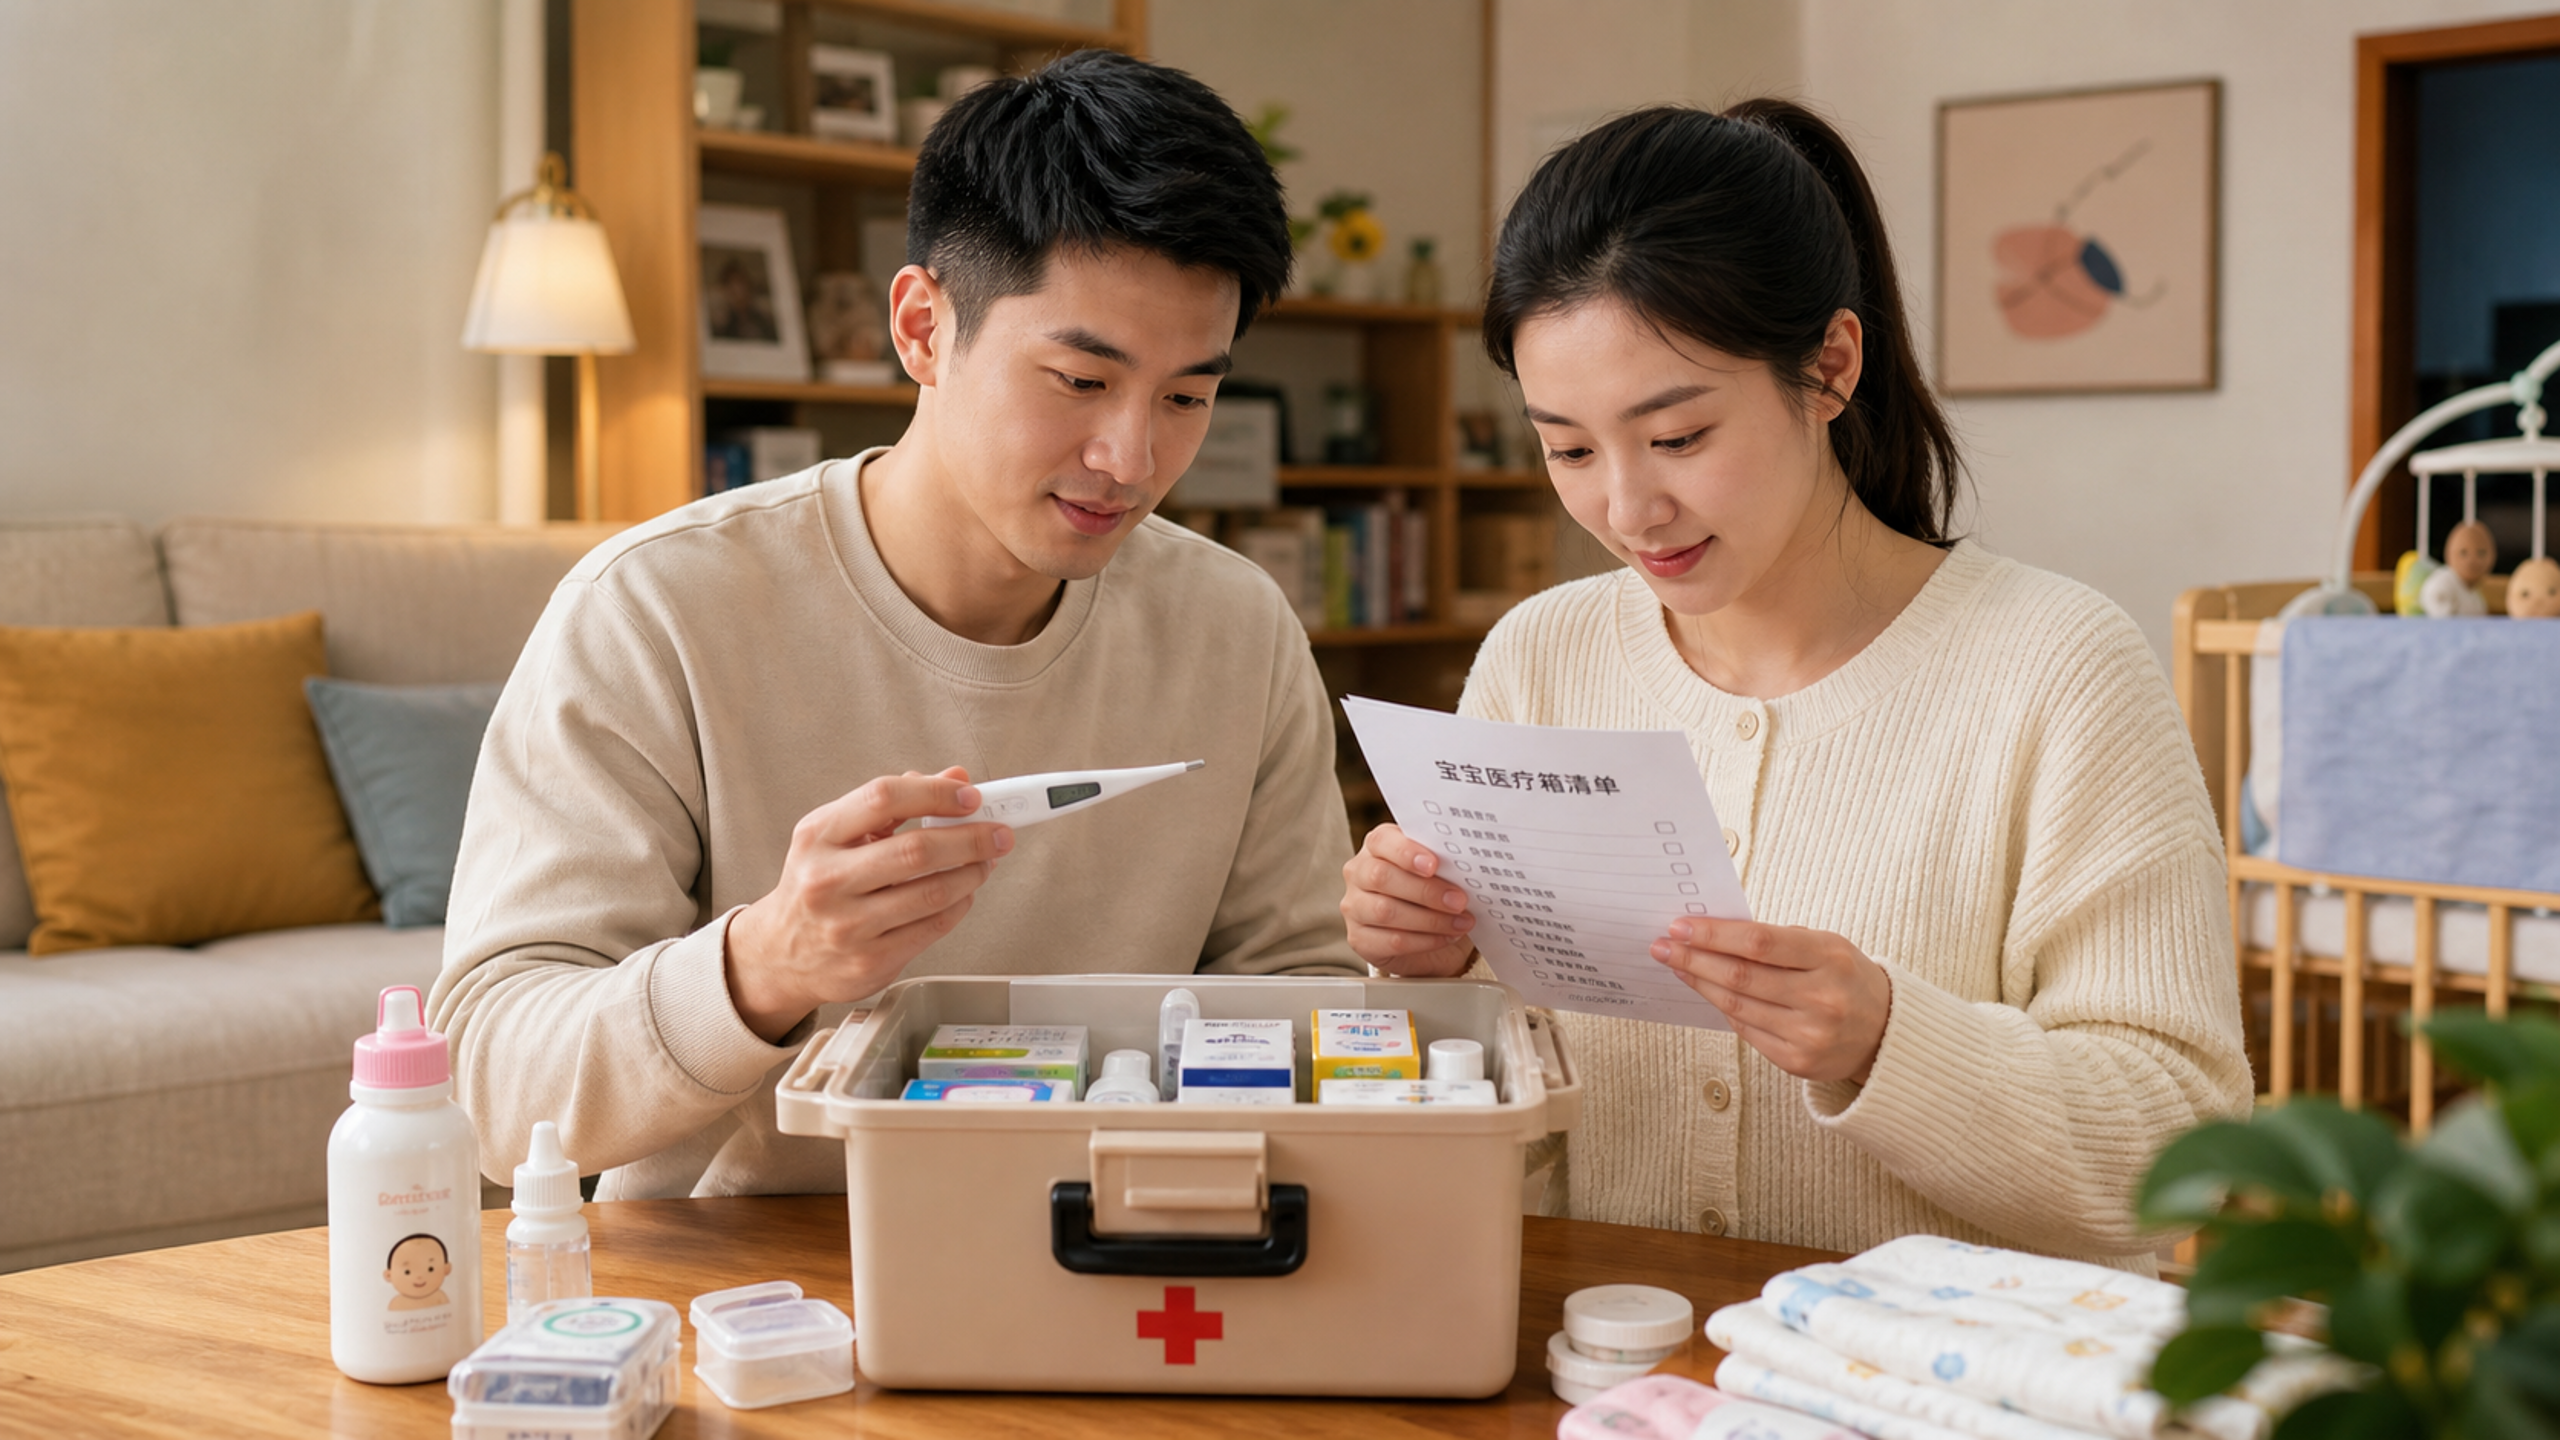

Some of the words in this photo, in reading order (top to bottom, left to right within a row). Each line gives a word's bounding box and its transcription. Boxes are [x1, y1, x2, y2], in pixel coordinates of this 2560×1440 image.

[1434, 760, 1621, 795] 宝宝医疗箱清单
